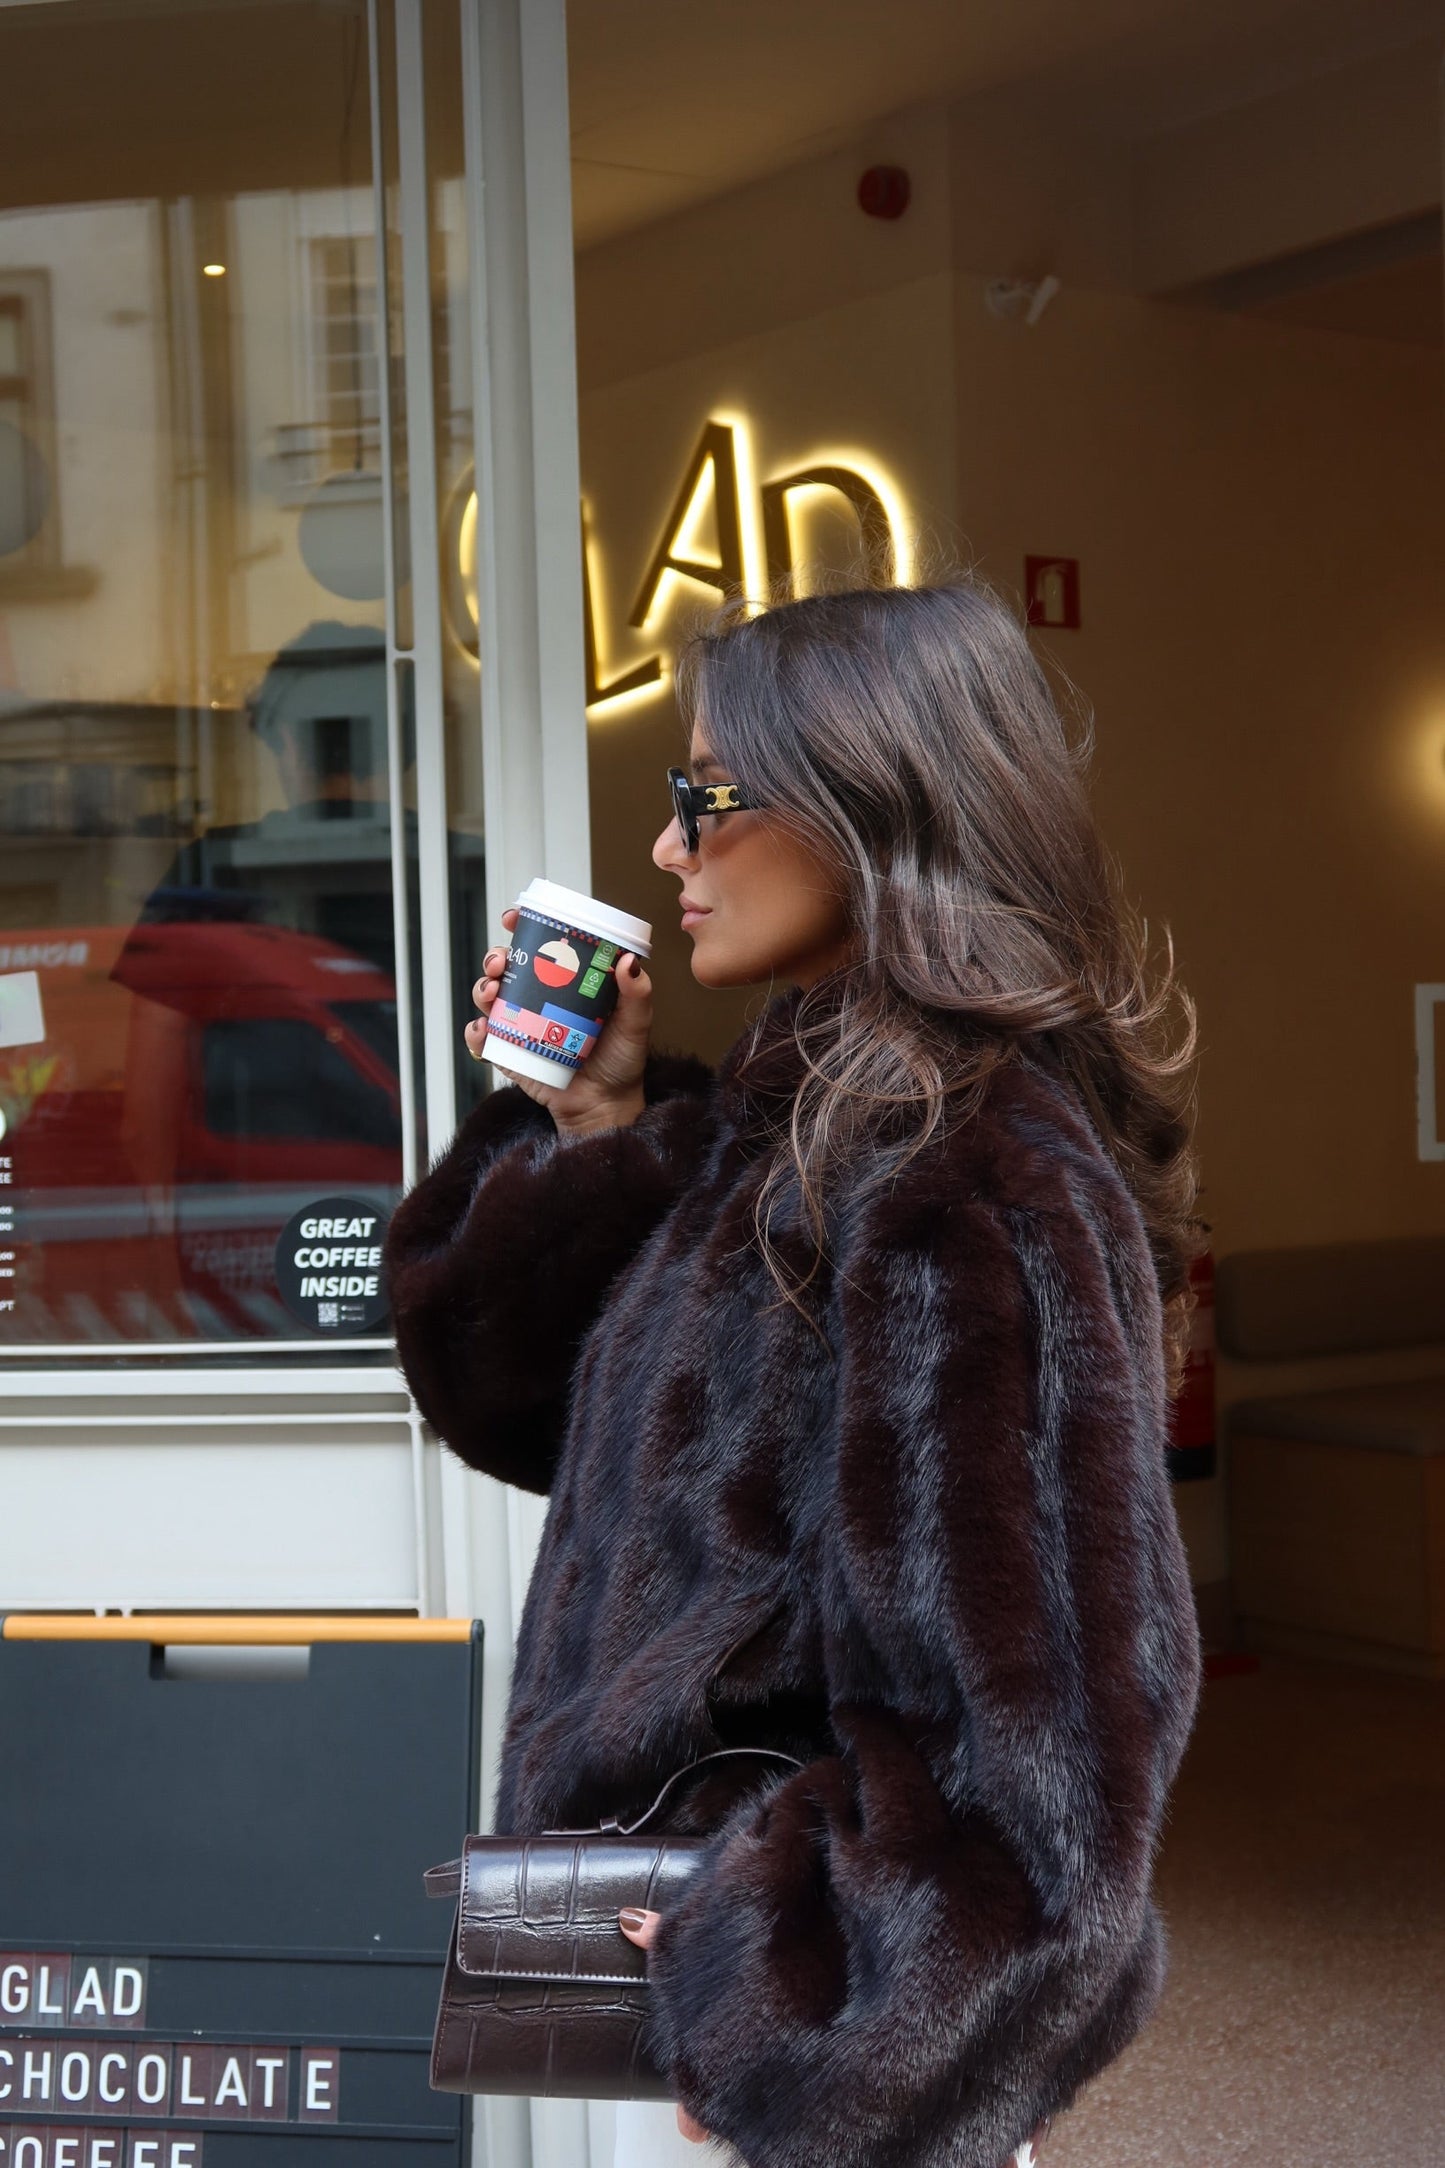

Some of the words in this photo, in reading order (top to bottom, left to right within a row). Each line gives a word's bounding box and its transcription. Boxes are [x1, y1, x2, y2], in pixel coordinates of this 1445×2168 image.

[441, 412, 914, 718] LAD
[300, 1217, 376, 1239] GREAT
[294, 1246, 382, 1268] COFFEE
[300, 1275, 378, 1297] INSIDE
[1, 1964, 142, 2016] GLAD
[0, 2136, 196, 2168] OFFEE
